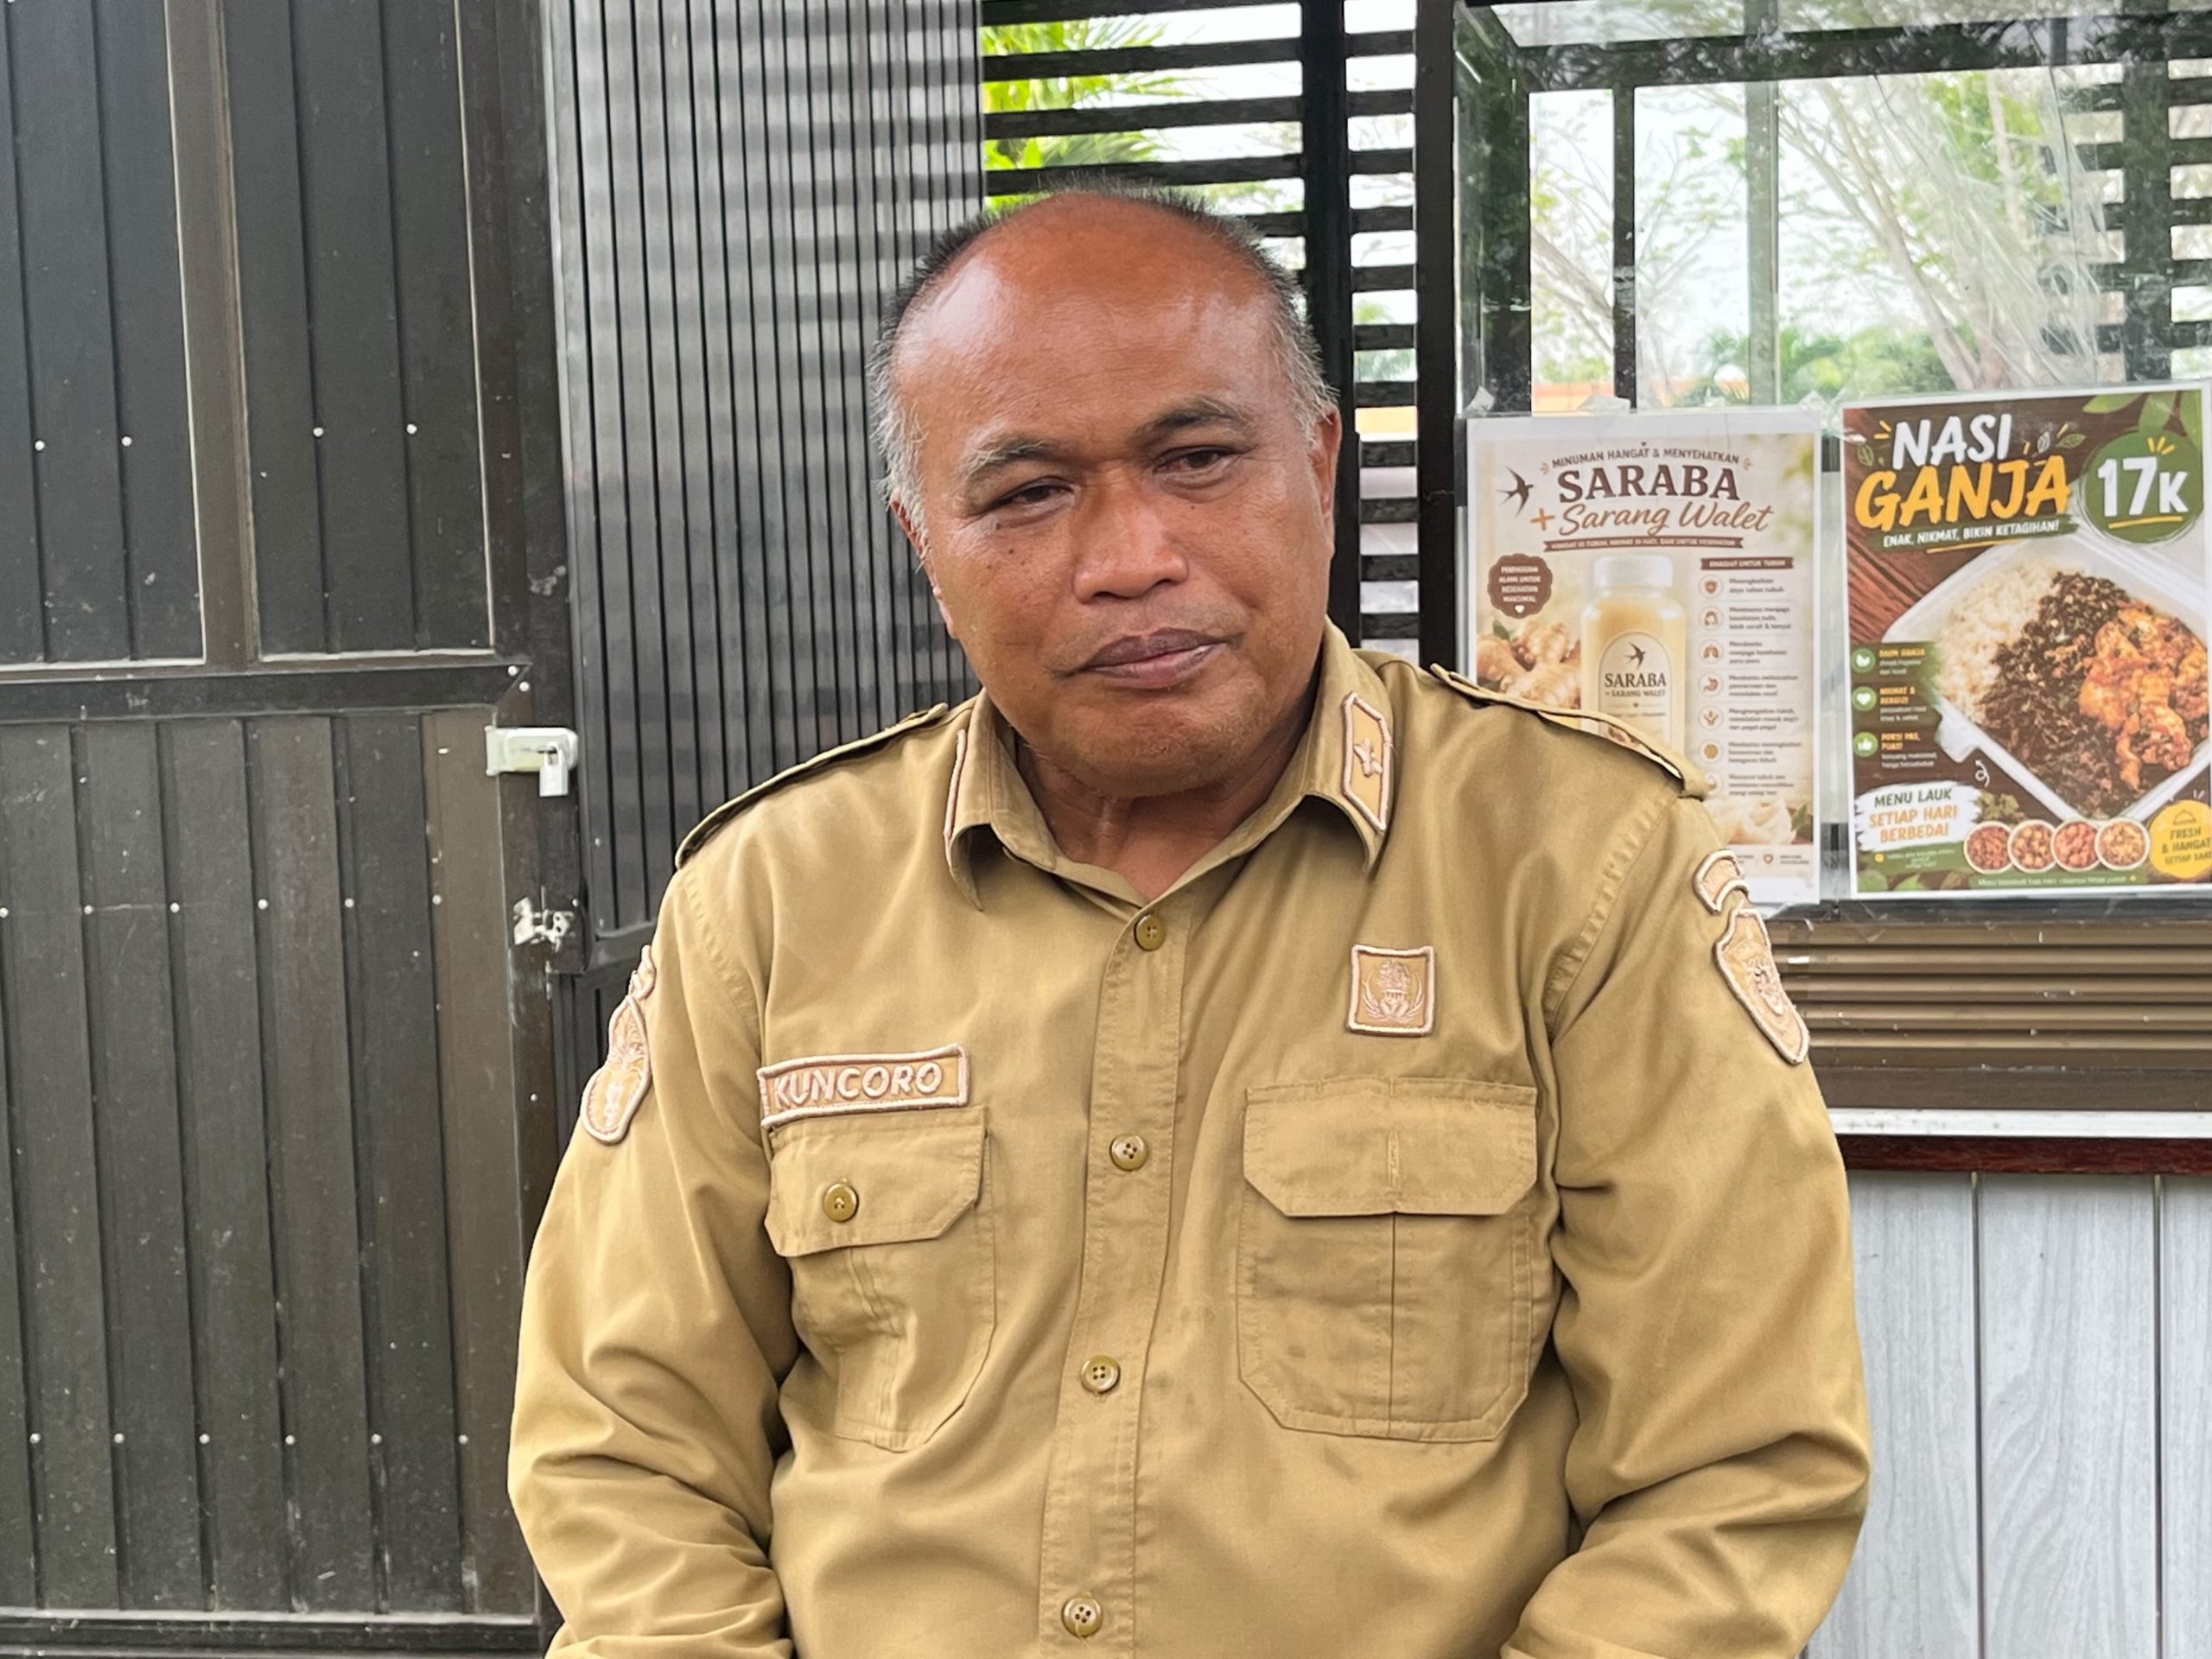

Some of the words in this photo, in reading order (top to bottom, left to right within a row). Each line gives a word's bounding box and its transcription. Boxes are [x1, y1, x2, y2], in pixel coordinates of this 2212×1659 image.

[1892, 413, 2012, 470] NASI
[1552, 452, 1604, 468] MINUMAN
[1608, 448, 1649, 460] HANGAT
[1653, 448, 1660, 458] &
[1663, 448, 1739, 464] MENYEHATKAN
[1558, 464, 1740, 503] SARABA
[1855, 455, 2071, 531] GANJA
[2098, 456, 2189, 517] 17K
[1559, 503, 1671, 536] Sarang
[1679, 501, 1775, 531] Walet
[1962, 526, 1993, 539] BIKIN
[1995, 518, 2060, 536] KETAGIHAN!
[1605, 672, 1667, 688] SARABA
[1874, 791, 1913, 808] MENU
[1918, 787, 1952, 803] LAUK
[1869, 809, 1918, 828] SETIAP
[1923, 804, 1958, 821] HARI
[1880, 823, 1949, 843] BERBEDA!
[2170, 826, 2201, 841] FRESH
[2172, 836, 2211, 852] HANGAT
[774, 1061, 943, 1109] KUNCORO
